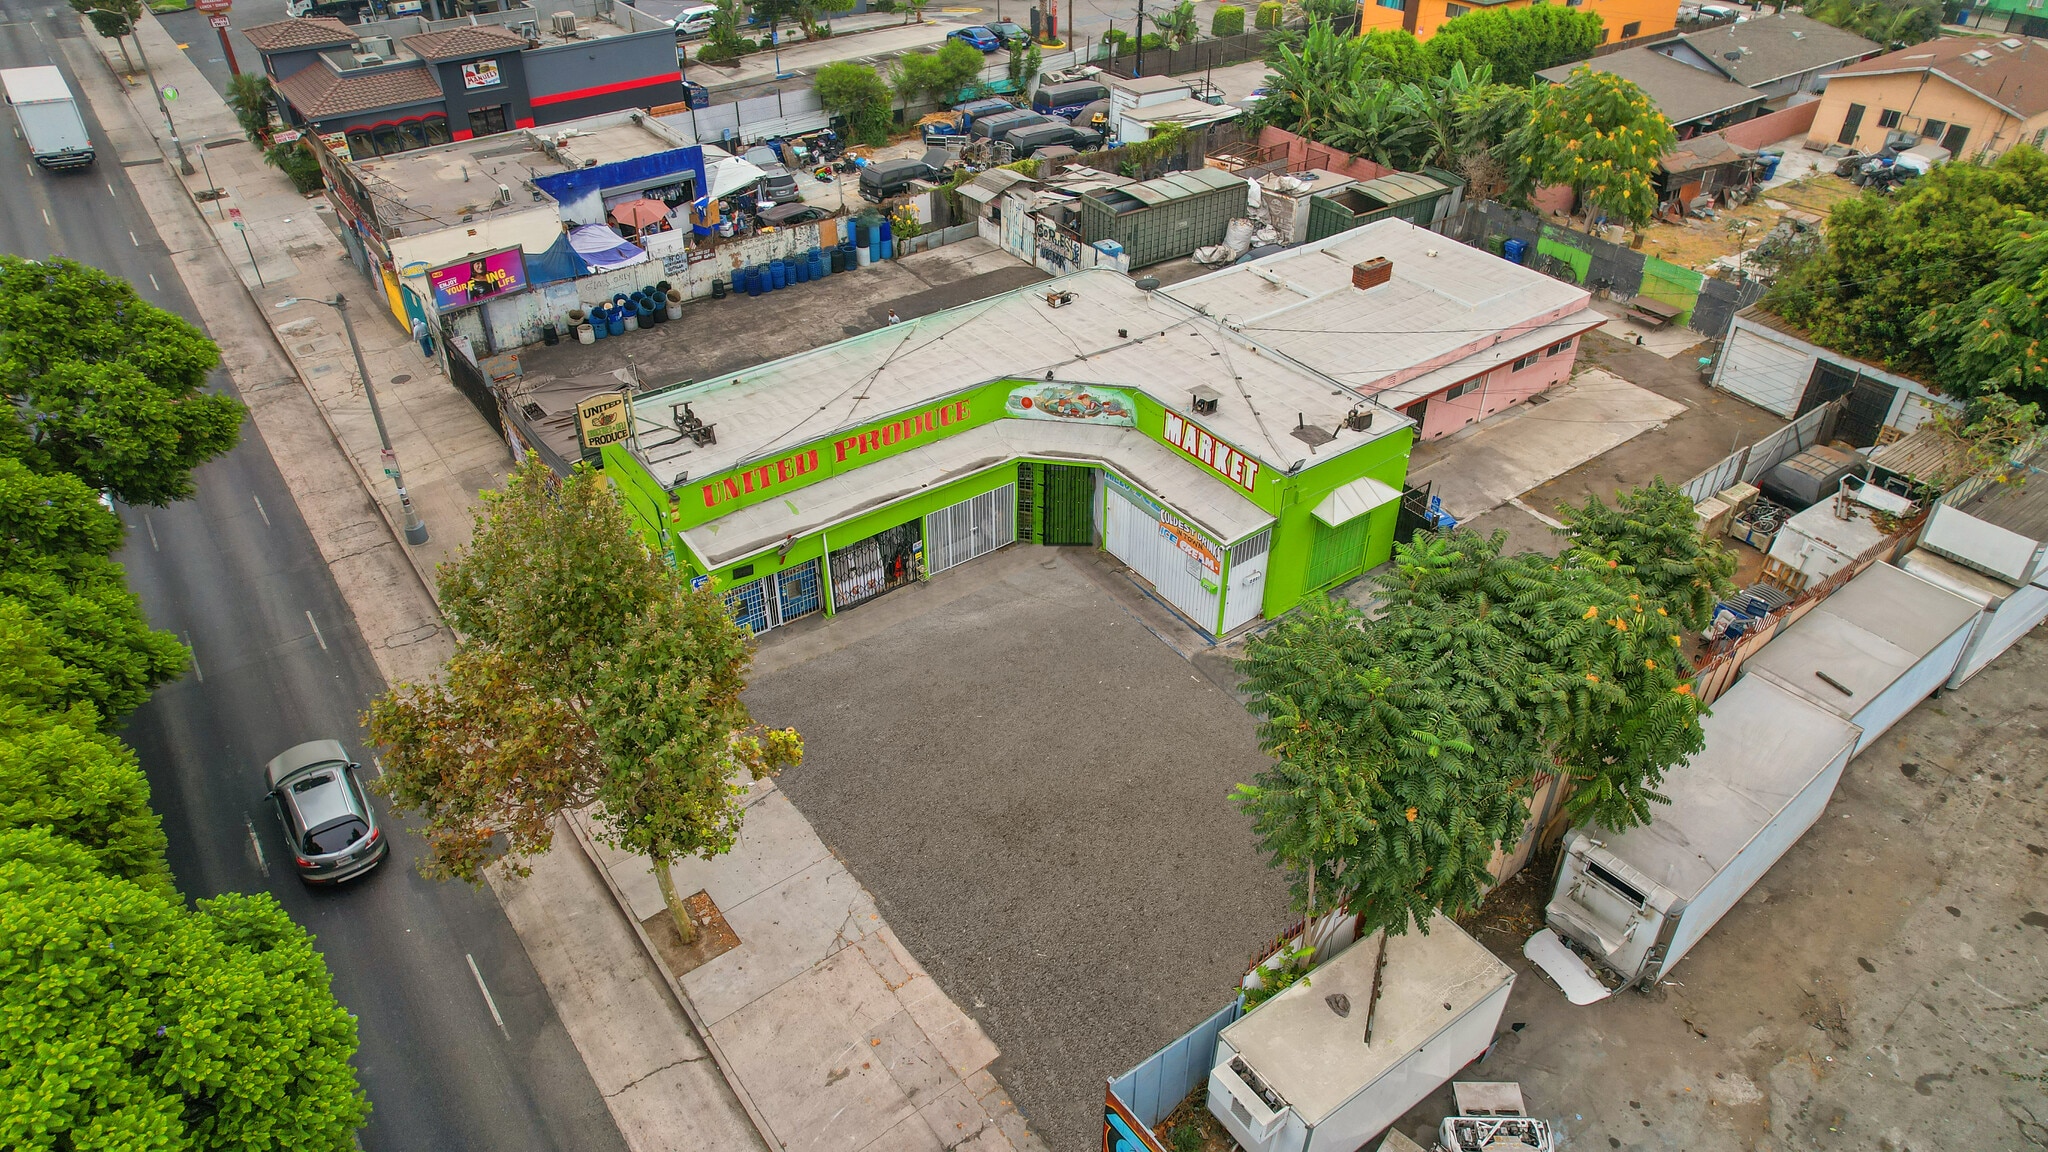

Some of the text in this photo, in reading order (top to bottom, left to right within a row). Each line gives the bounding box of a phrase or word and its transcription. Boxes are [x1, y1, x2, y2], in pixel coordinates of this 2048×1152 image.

[439, 278, 457, 288] ENJOY
[497, 275, 516, 288] LIFE
[613, 272, 631, 284] ONLY
[445, 284, 467, 296] YOUR
[582, 399, 622, 419] UNITED
[588, 429, 628, 446] PRODUCE
[701, 399, 971, 508] UNITED PRODUCE
[1163, 408, 1259, 493] MARKET
[1160, 525, 1178, 545] ICE
[1160, 509, 1221, 563] COLDEST DRINKS
[1183, 532, 1204, 551] TOWN
